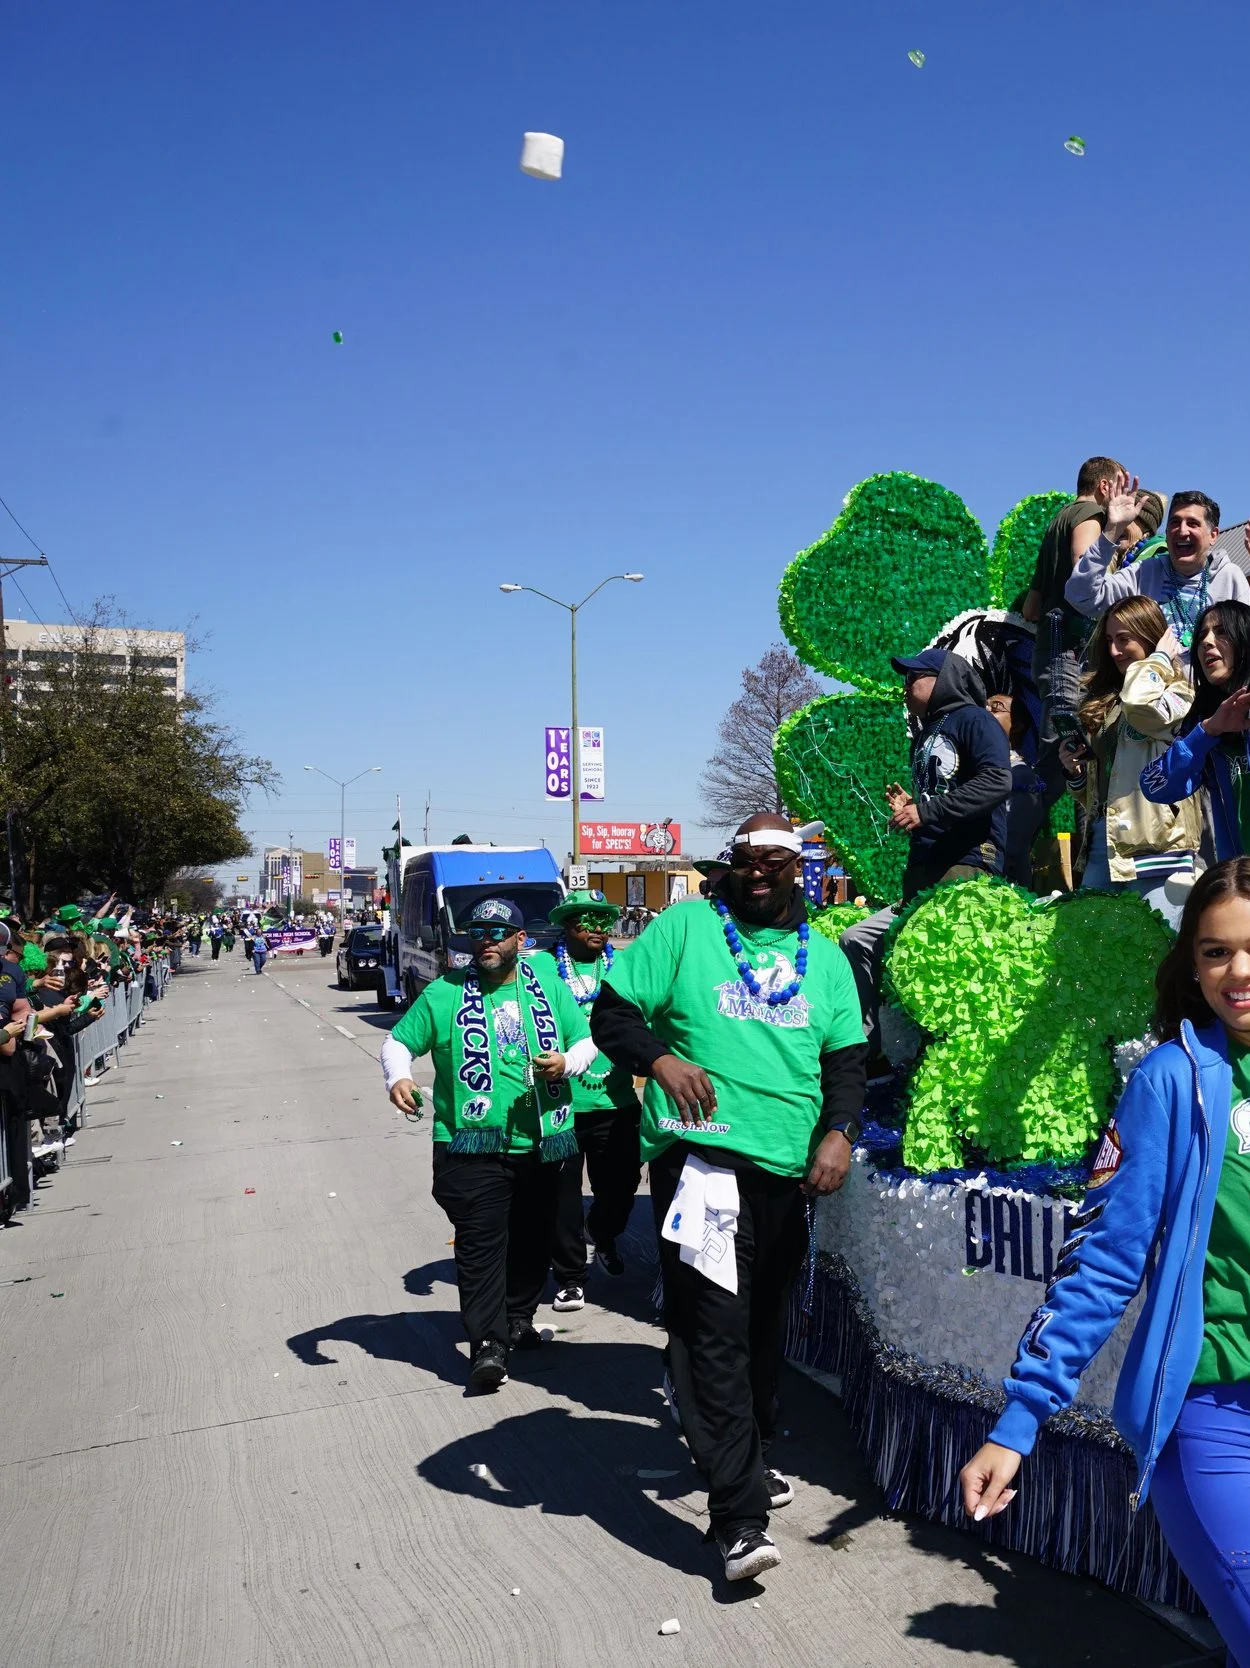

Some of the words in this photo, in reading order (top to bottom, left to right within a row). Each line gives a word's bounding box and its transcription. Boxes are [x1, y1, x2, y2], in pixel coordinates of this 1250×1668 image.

[559, 730, 569, 792] YEARS
[581, 825, 595, 838] Sip,
[596, 825, 609, 838] Sip,
[611, 826, 635, 839] Hooray
[592, 839, 602, 849] for
[605, 839, 631, 849] SPEC'S!
[571, 876, 586, 886] 35
[965, 1190, 1075, 1284] DALL
